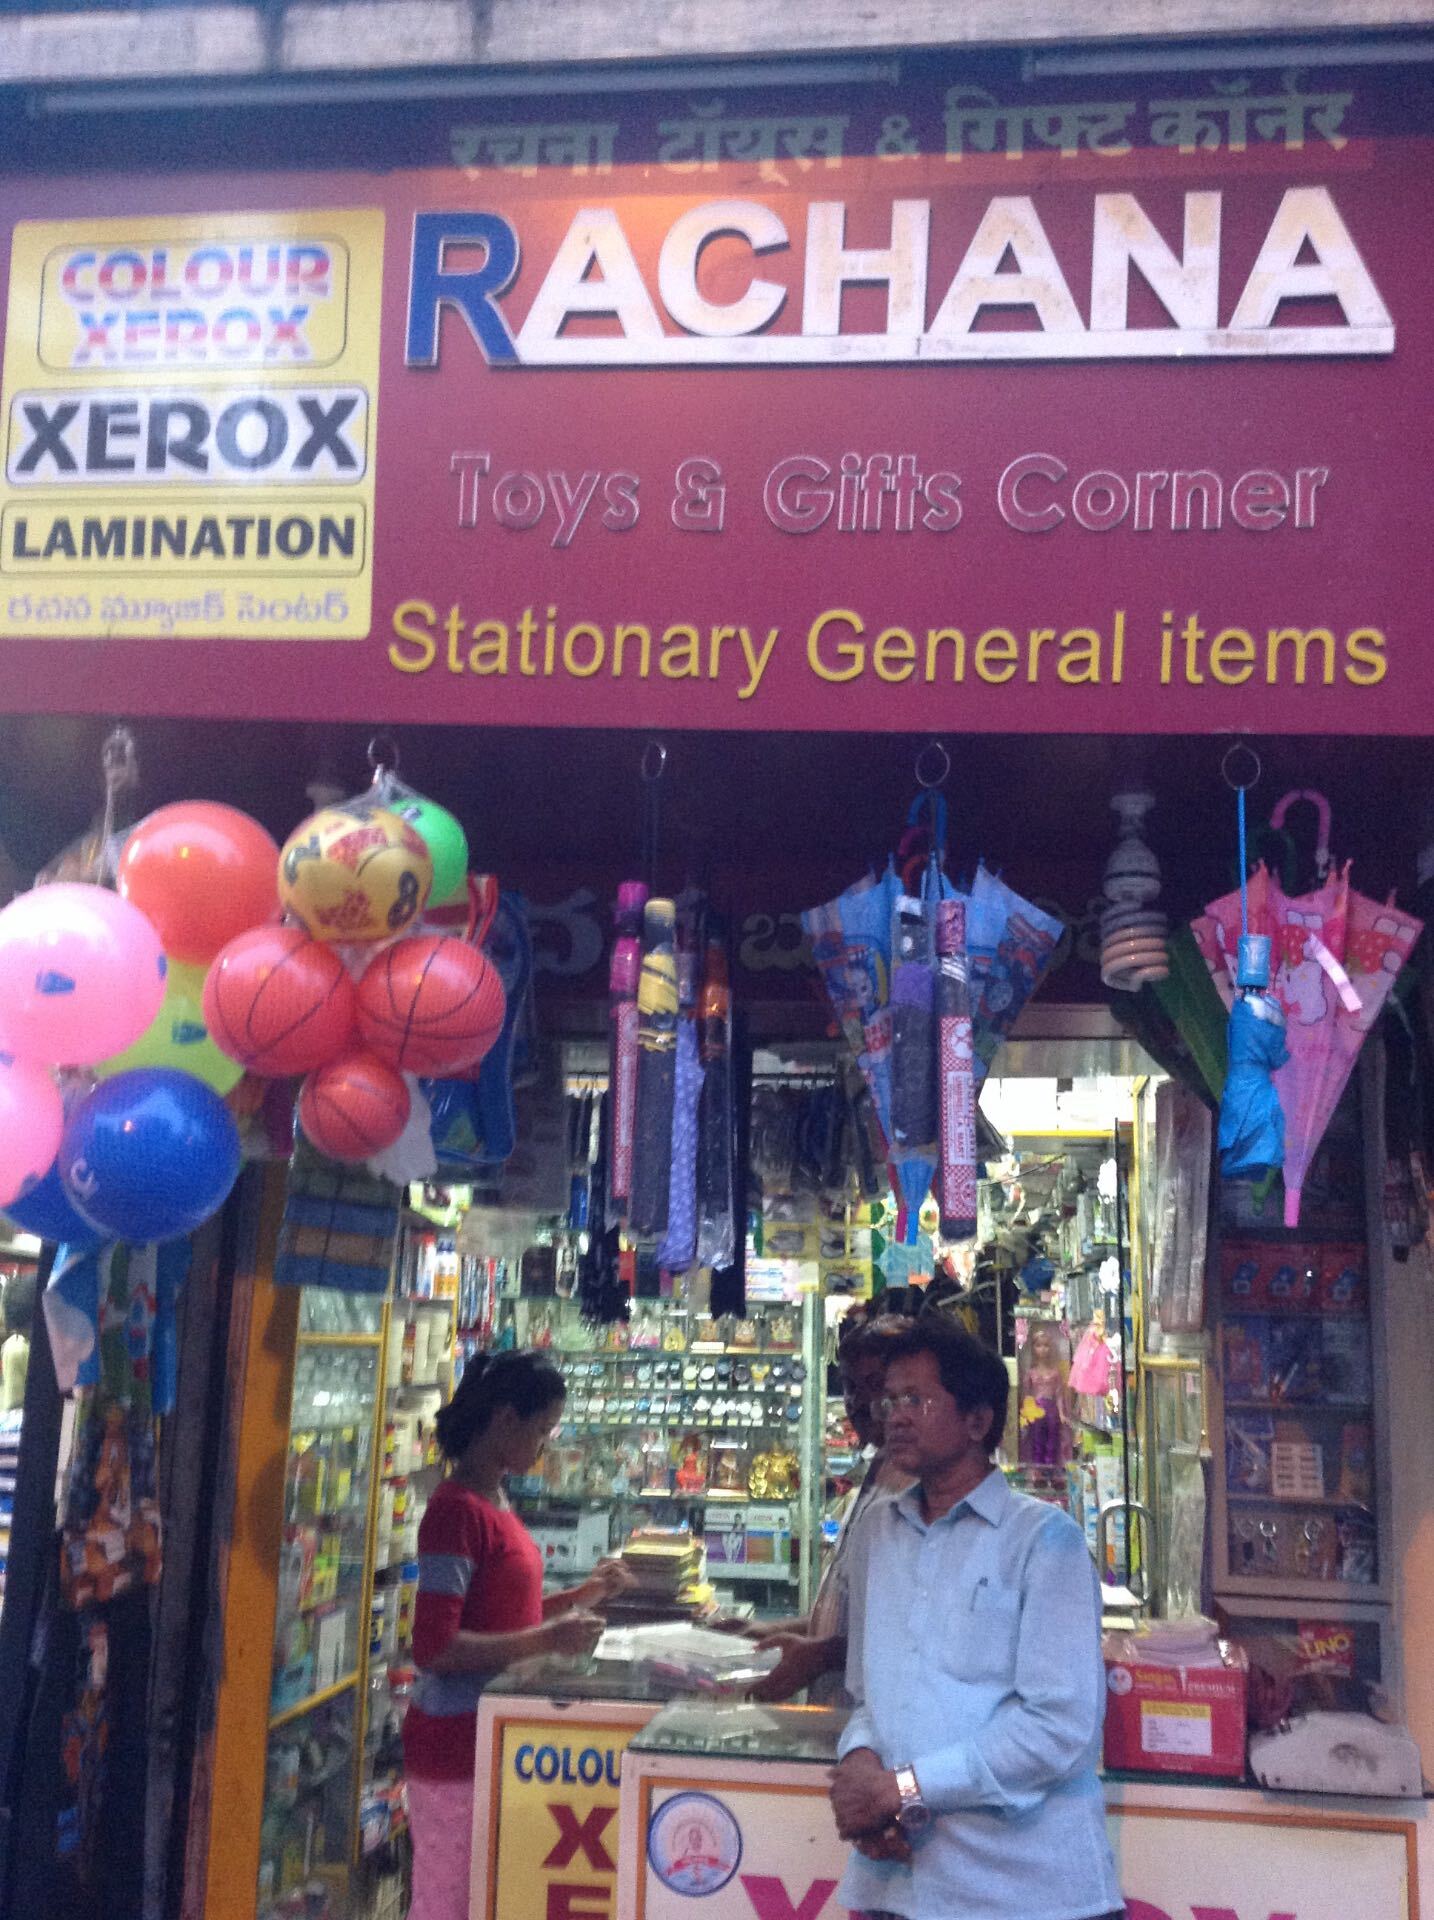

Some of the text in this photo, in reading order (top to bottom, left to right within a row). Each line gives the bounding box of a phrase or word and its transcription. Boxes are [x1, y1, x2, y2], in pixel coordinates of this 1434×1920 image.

[875, 115, 920, 162] &
[61, 242, 332, 302] COLOUR
[404, 187, 1395, 370] RACHANA
[72, 303, 312, 366] XEROX
[14, 394, 361, 476] XEROX
[449, 450, 1331, 548] Toys & Gifts Corner
[11, 515, 356, 561] LAMINATION
[387, 598, 1388, 700] Stationary General items
[1302, 1632, 1350, 1659] UNO
